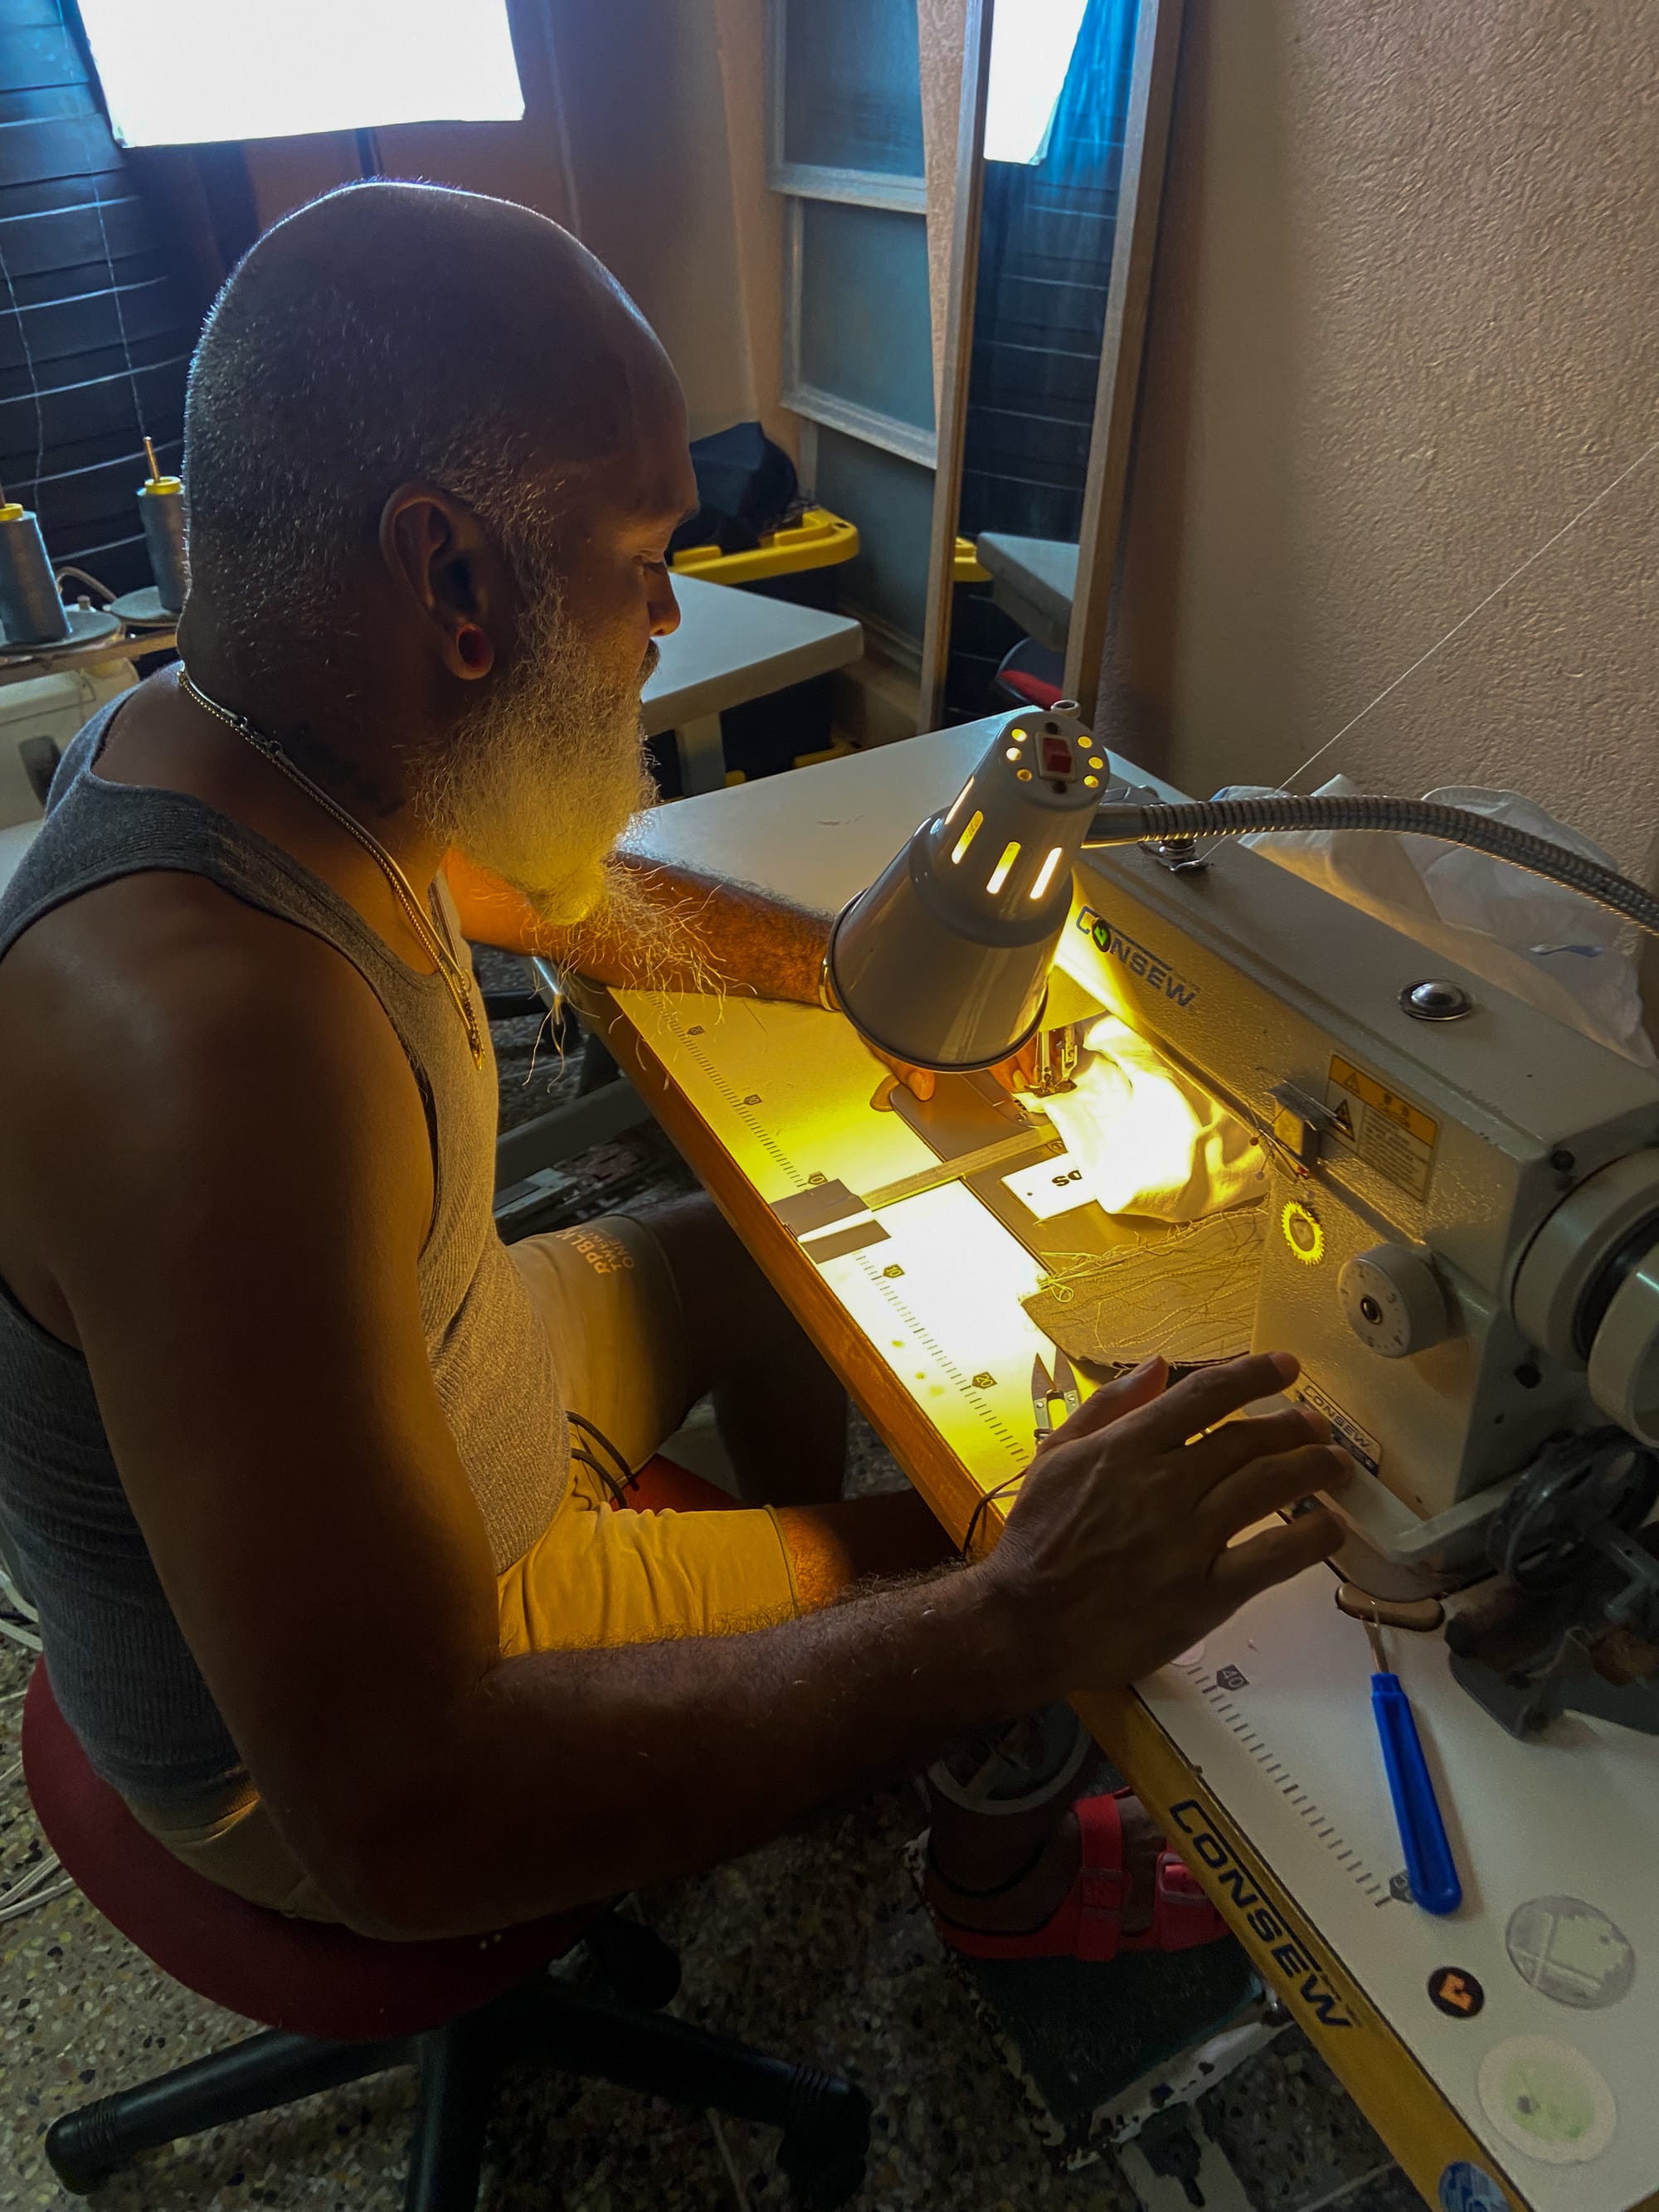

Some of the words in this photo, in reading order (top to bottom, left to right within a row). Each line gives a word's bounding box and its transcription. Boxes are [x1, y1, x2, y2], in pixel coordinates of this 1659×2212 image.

[1076, 906, 1195, 1006] CNSEW
[555, 1226, 611, 1274] RPBLK
[975, 1374, 994, 1387] 20
[1304, 1386, 1370, 1447] CONSEW
[1221, 1670, 1244, 1688] 40
[1169, 1798, 1352, 2027] CONSEW
